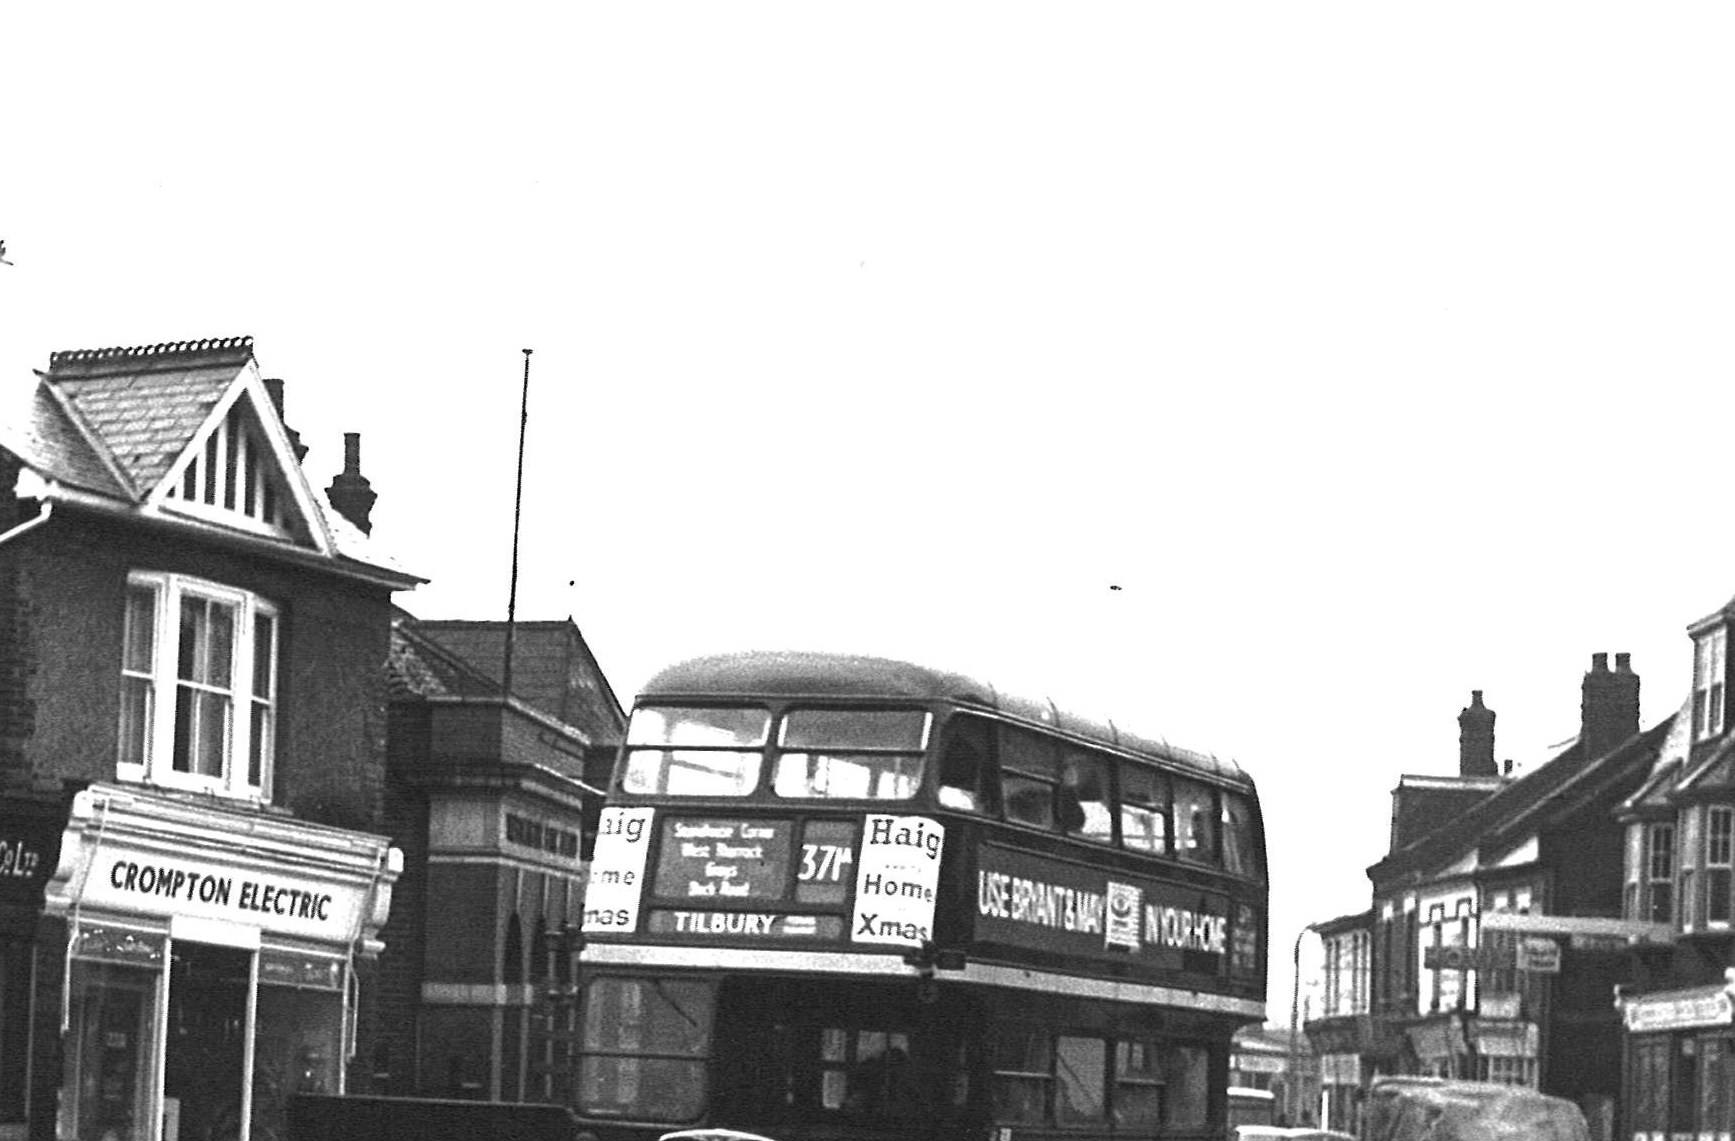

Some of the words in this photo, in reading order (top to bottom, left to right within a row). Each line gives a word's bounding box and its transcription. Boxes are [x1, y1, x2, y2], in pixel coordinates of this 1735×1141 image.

[870, 818, 941, 860] Haig
[111, 861, 232, 906] CROMPTON
[239, 882, 332, 921] ELECTRIC
[863, 873, 932, 903] Home
[979, 870, 1010, 918] USE
[674, 912, 776, 935] TILBURY
[856, 913, 928, 941] Xmas
[1193, 912, 1226, 954] HOME
